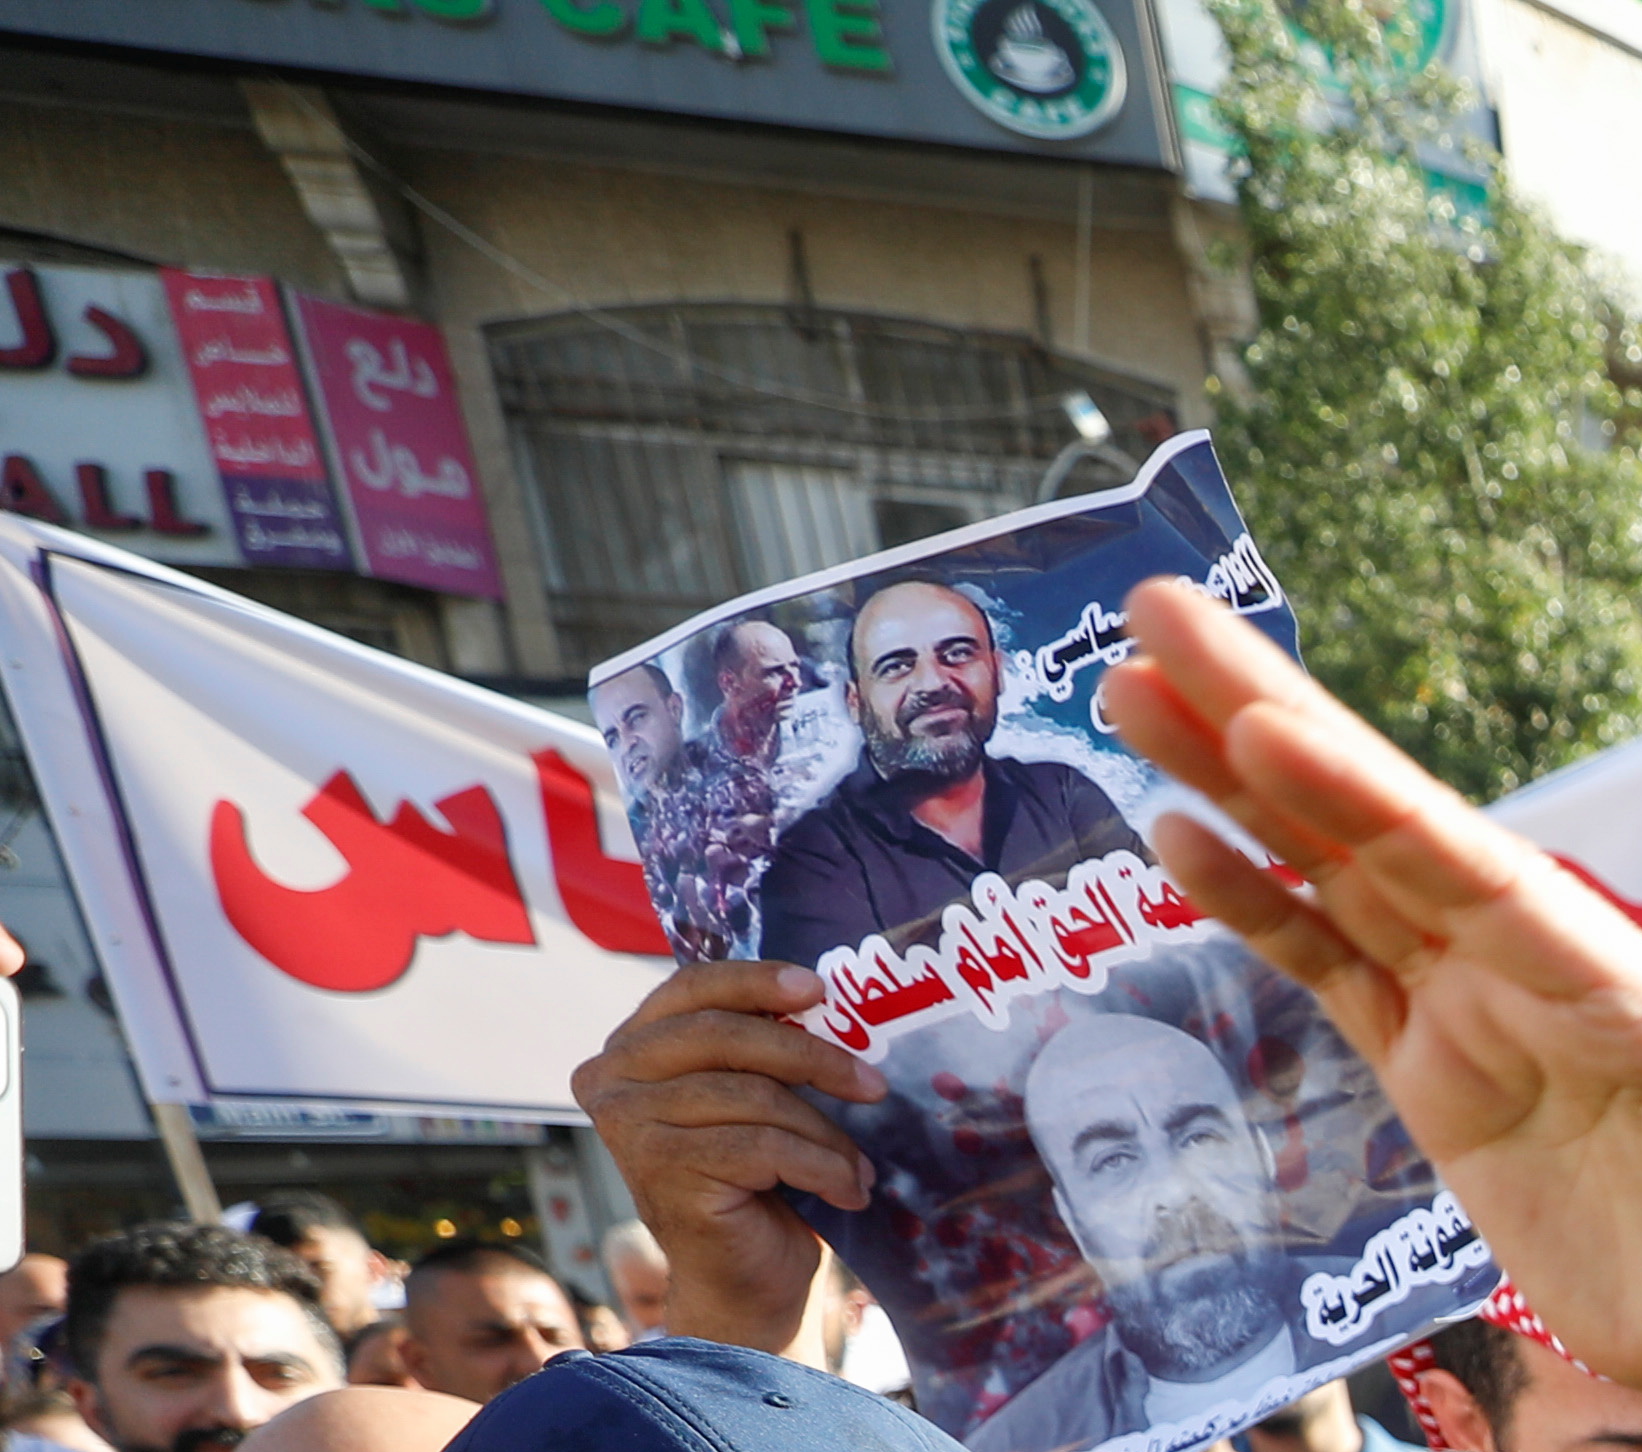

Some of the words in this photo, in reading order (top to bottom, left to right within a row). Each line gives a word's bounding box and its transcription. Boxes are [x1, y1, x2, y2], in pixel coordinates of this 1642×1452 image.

[956, 888, 1046, 1015] أمام
[1051, 876, 1137, 980] الحق
[1313, 1246, 1401, 1333] الحرية
